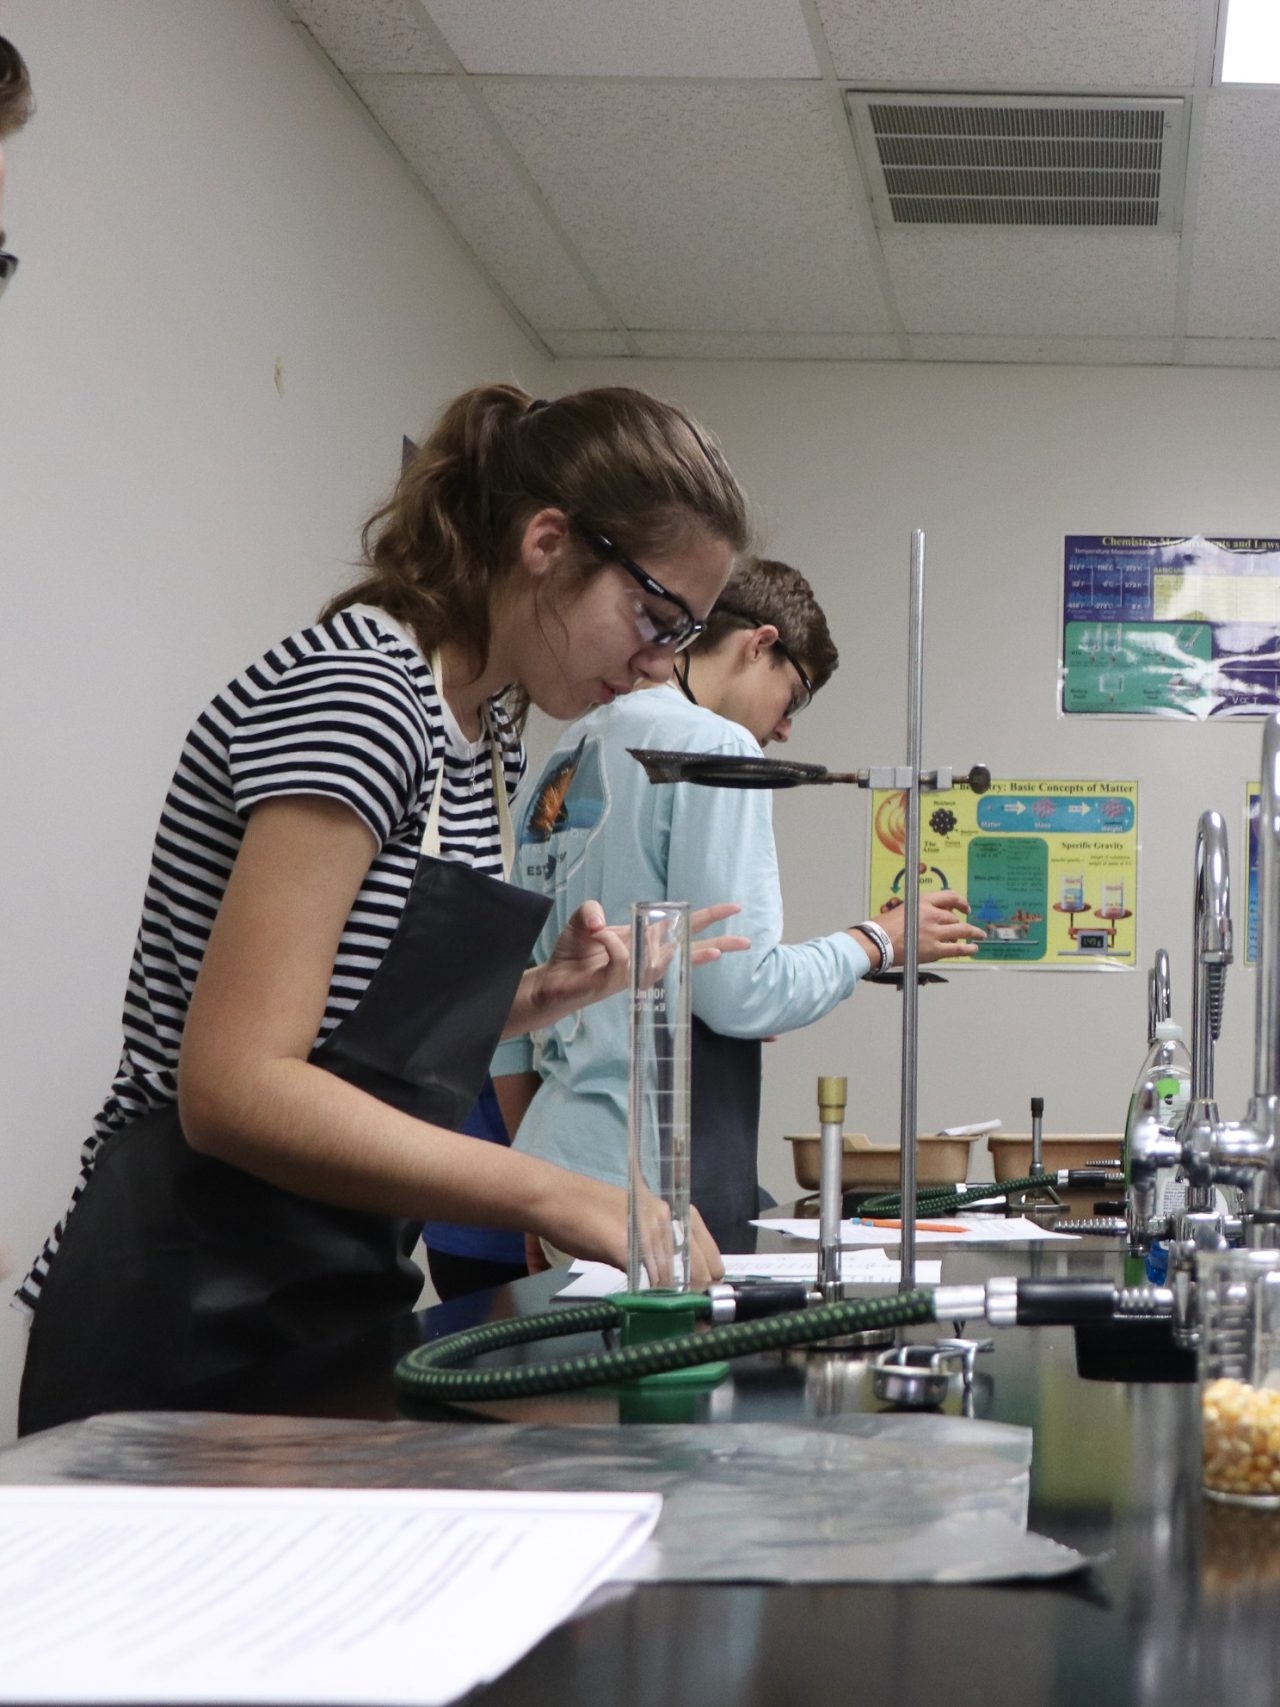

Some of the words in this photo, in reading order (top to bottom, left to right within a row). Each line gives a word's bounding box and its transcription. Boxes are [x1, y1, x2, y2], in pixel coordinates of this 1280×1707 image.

[1233, 539, 1251, 549] and
[1254, 540, 1280, 550] Laws
[1010, 782, 1036, 792] Basic
[1038, 783, 1084, 795] Concepts
[1087, 783, 1097, 793] of
[1100, 784, 1134, 794] Matter
[1062, 842, 1092, 850] Specific
[1094, 842, 1124, 850] Gravity
